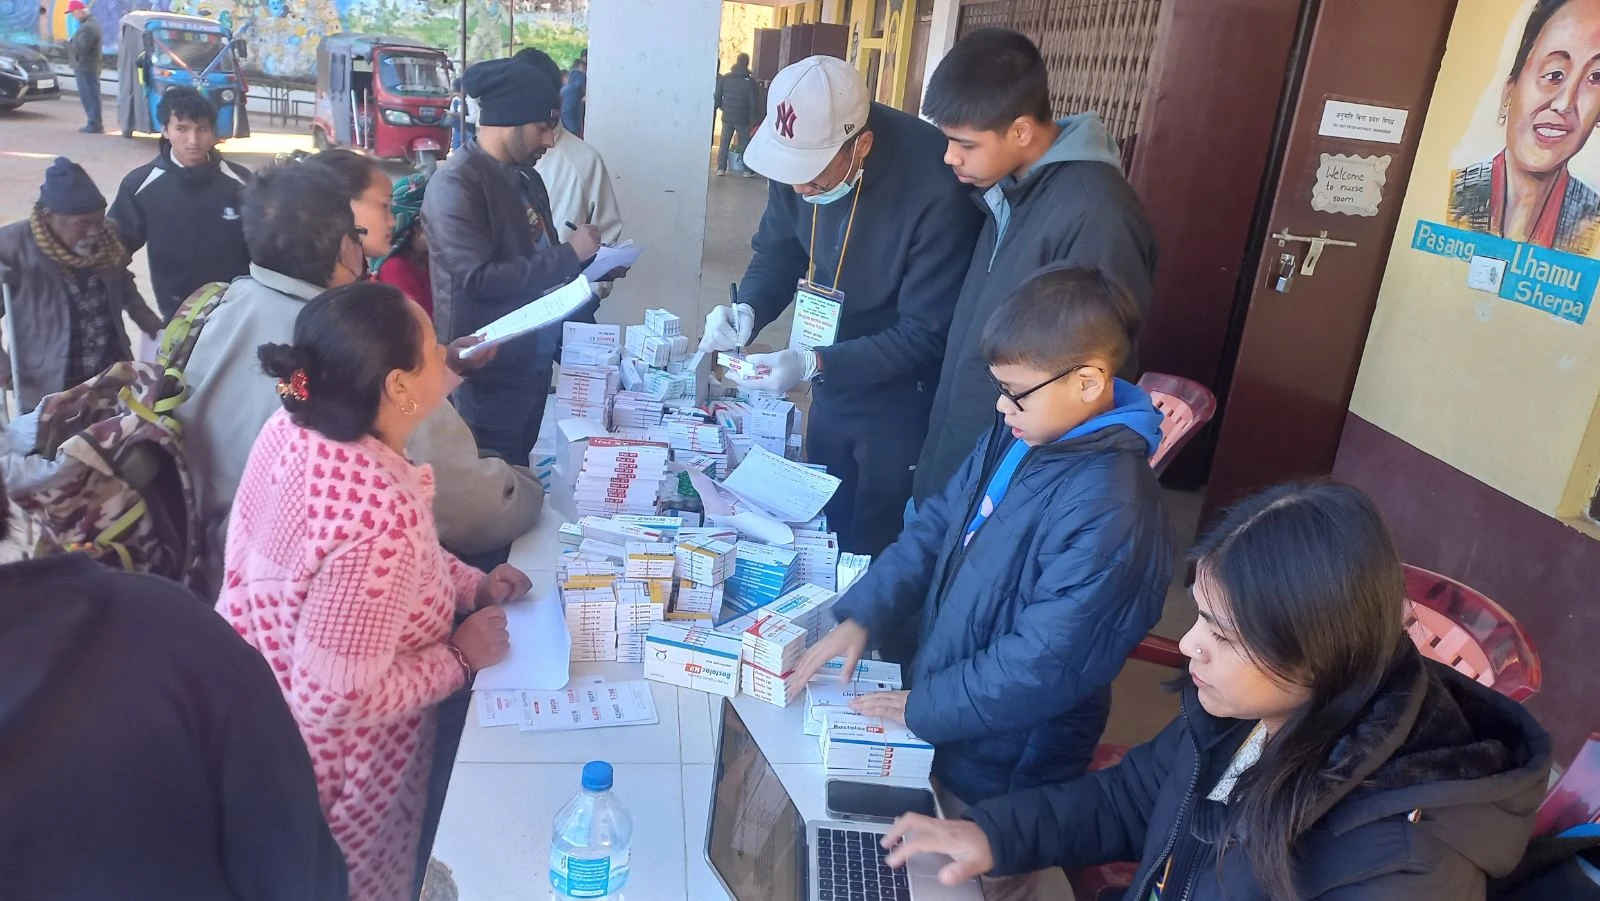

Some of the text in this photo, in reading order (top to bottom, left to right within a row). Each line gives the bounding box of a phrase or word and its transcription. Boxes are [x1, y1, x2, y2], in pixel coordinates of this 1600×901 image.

[1326, 165, 1364, 181] Welcome
[1326, 181, 1334, 191] to
[1417, 224, 1582, 290] Pasang Lhamu
[1515, 281, 1584, 318] Sherpa
[702, 667, 731, 680] Bactolac
